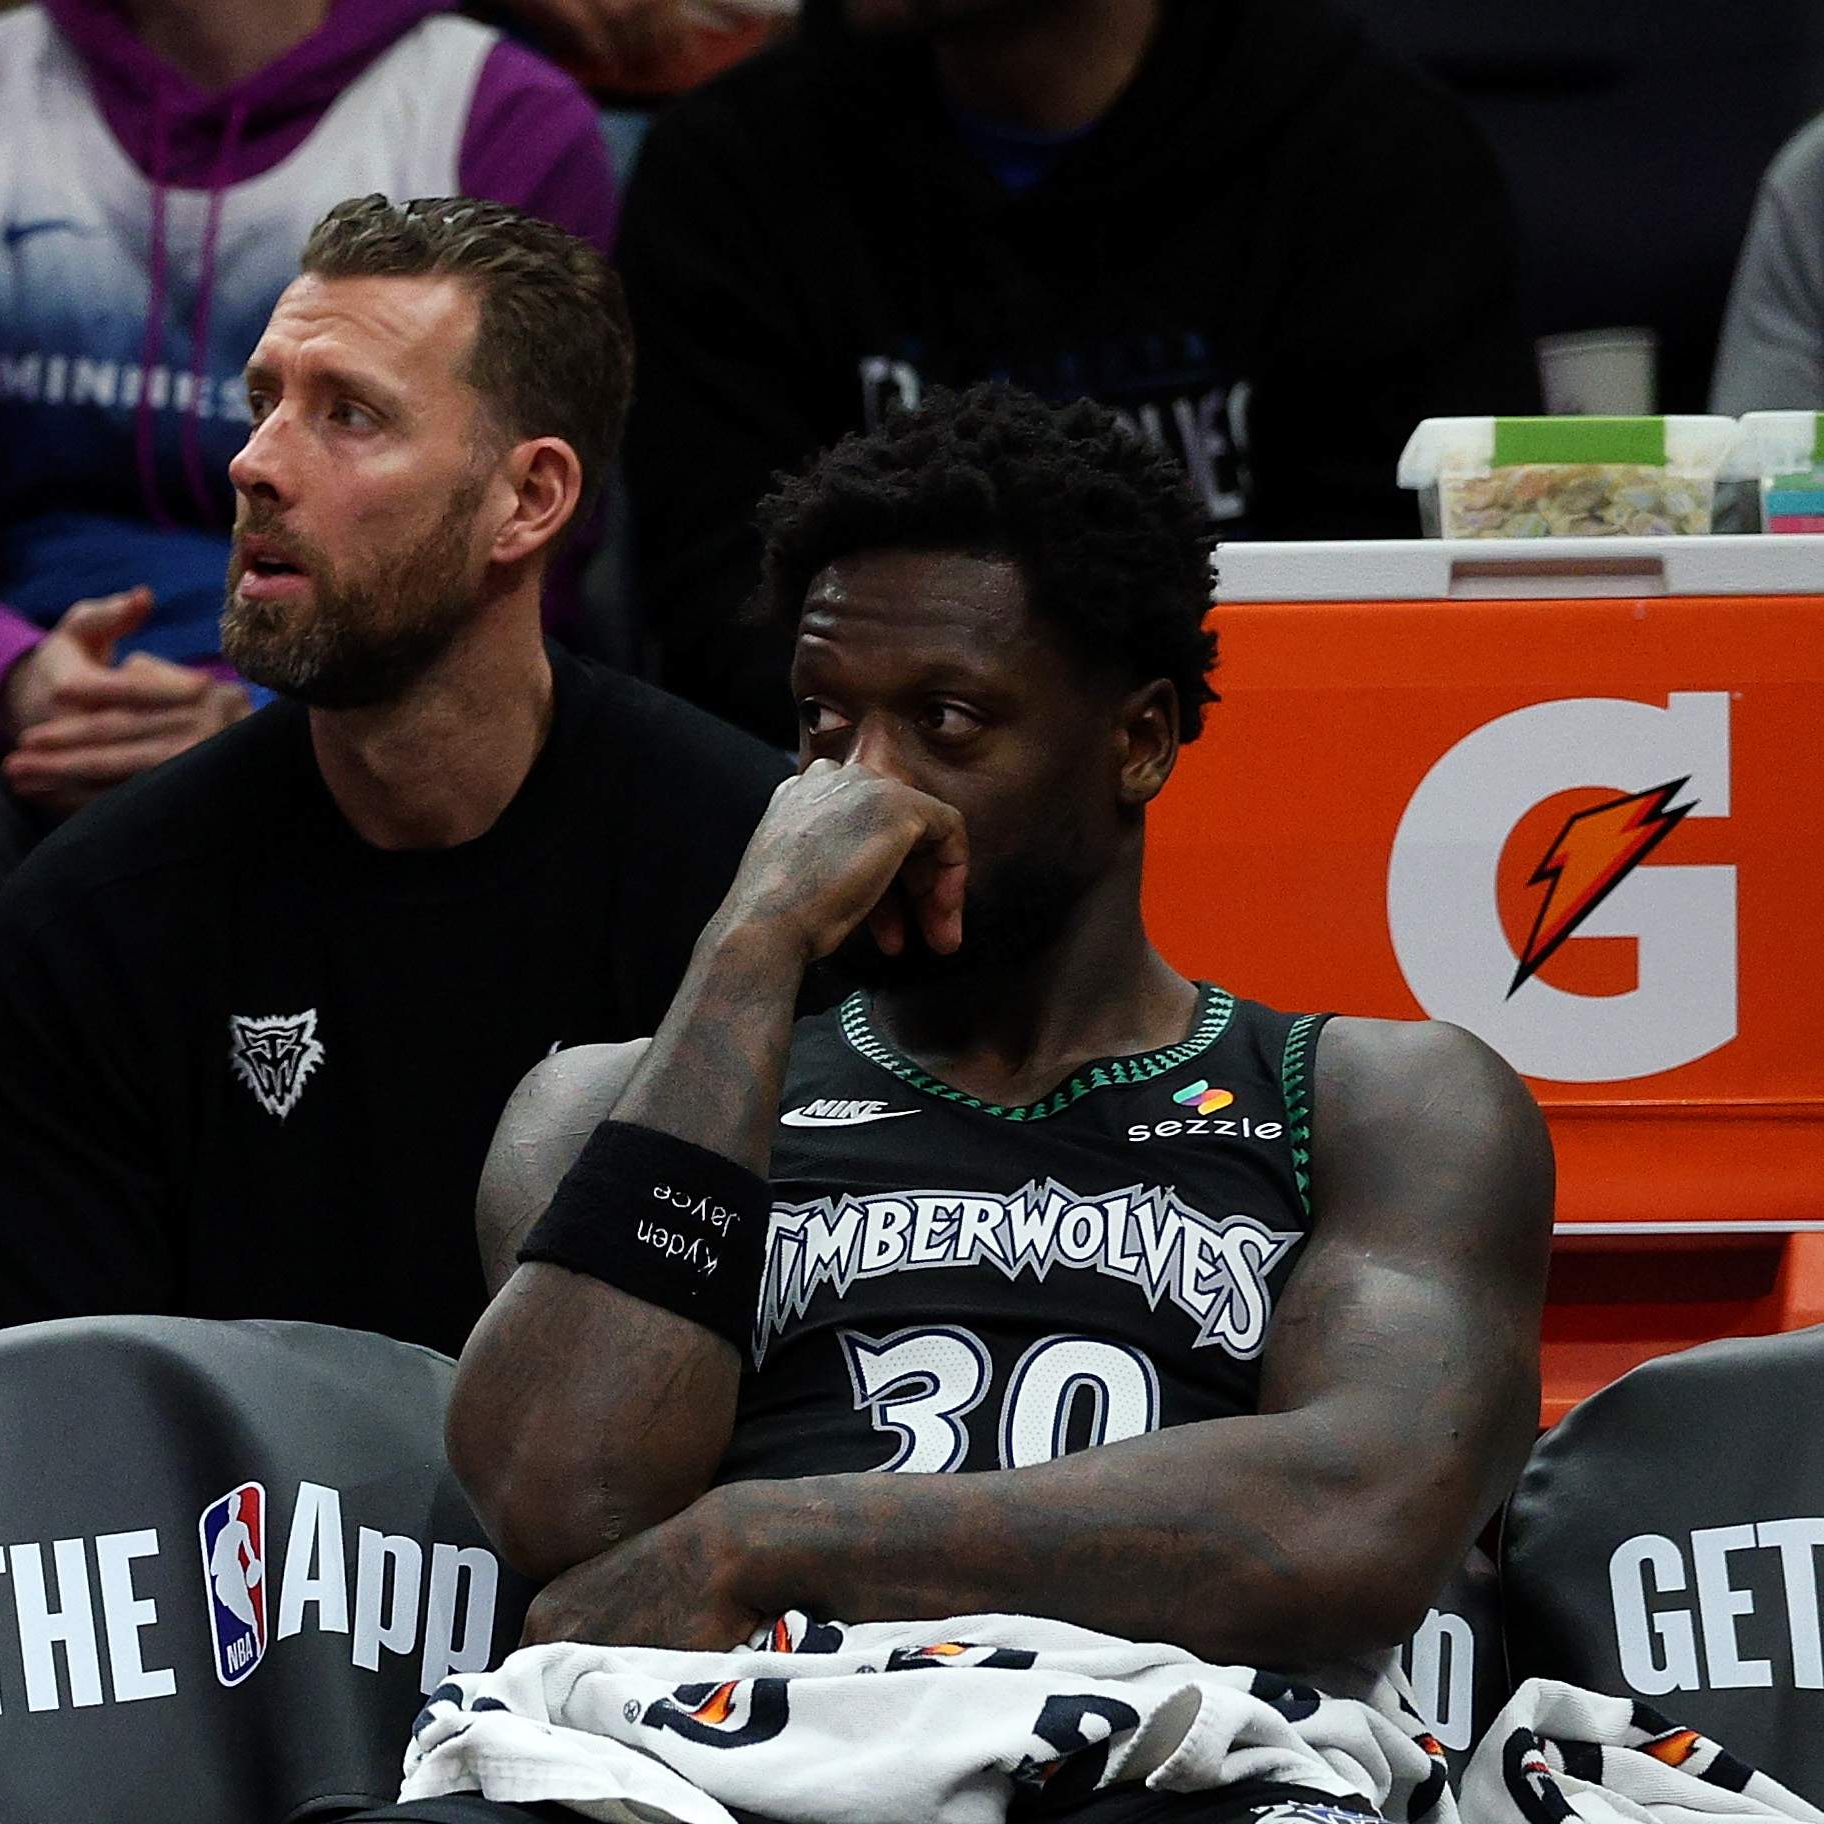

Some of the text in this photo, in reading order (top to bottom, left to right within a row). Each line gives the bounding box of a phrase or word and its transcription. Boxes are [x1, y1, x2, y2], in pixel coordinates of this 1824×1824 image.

[804, 1098, 889, 1119] NIKE
[1127, 1115, 1284, 1143] sezzle
[755, 1177, 1304, 1372] TIMBERWOLVES
[837, 1324, 1161, 1475] 30
[226, 1631, 254, 1674] NBA
[276, 1480, 500, 1696] App
[1609, 1517, 1824, 1696] GET
